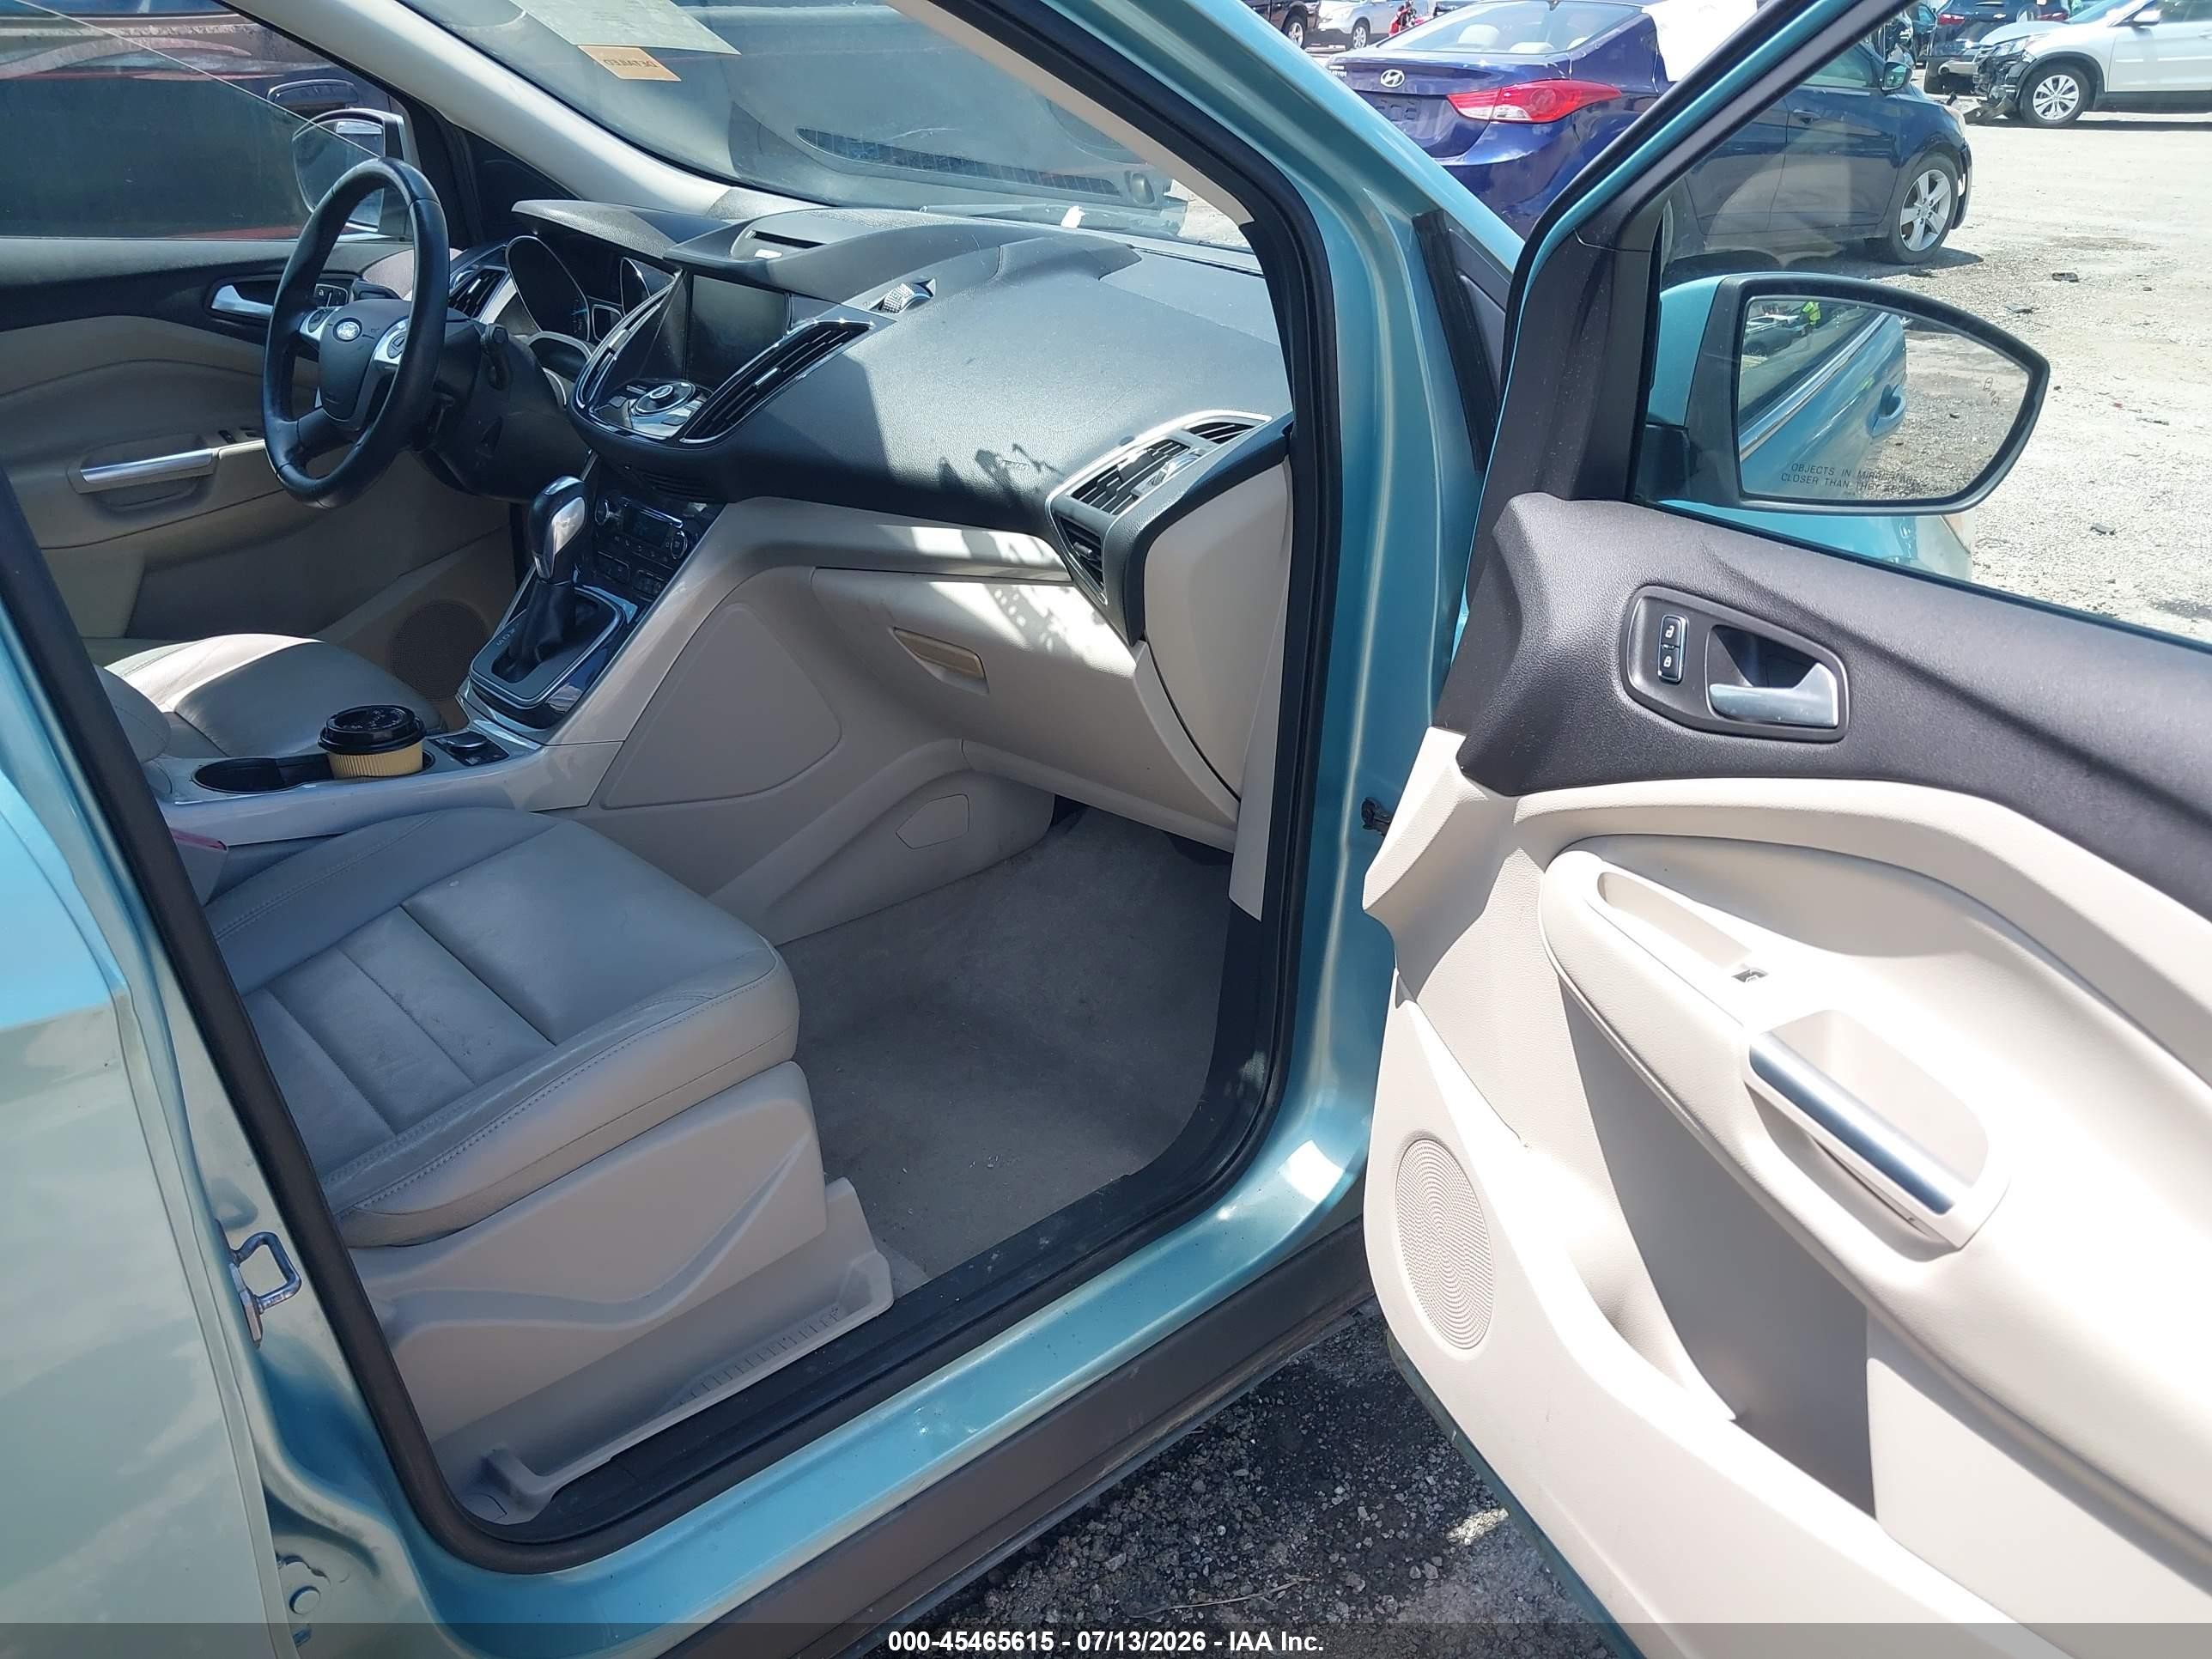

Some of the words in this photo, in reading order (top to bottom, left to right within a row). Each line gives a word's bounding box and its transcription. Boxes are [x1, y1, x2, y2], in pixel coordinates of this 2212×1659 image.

[1791, 462, 1835, 476] OBJECTS
[1841, 466, 1851, 477] IN
[1781, 472, 1819, 484] CLOSER
[1824, 477, 1849, 489] THAN
